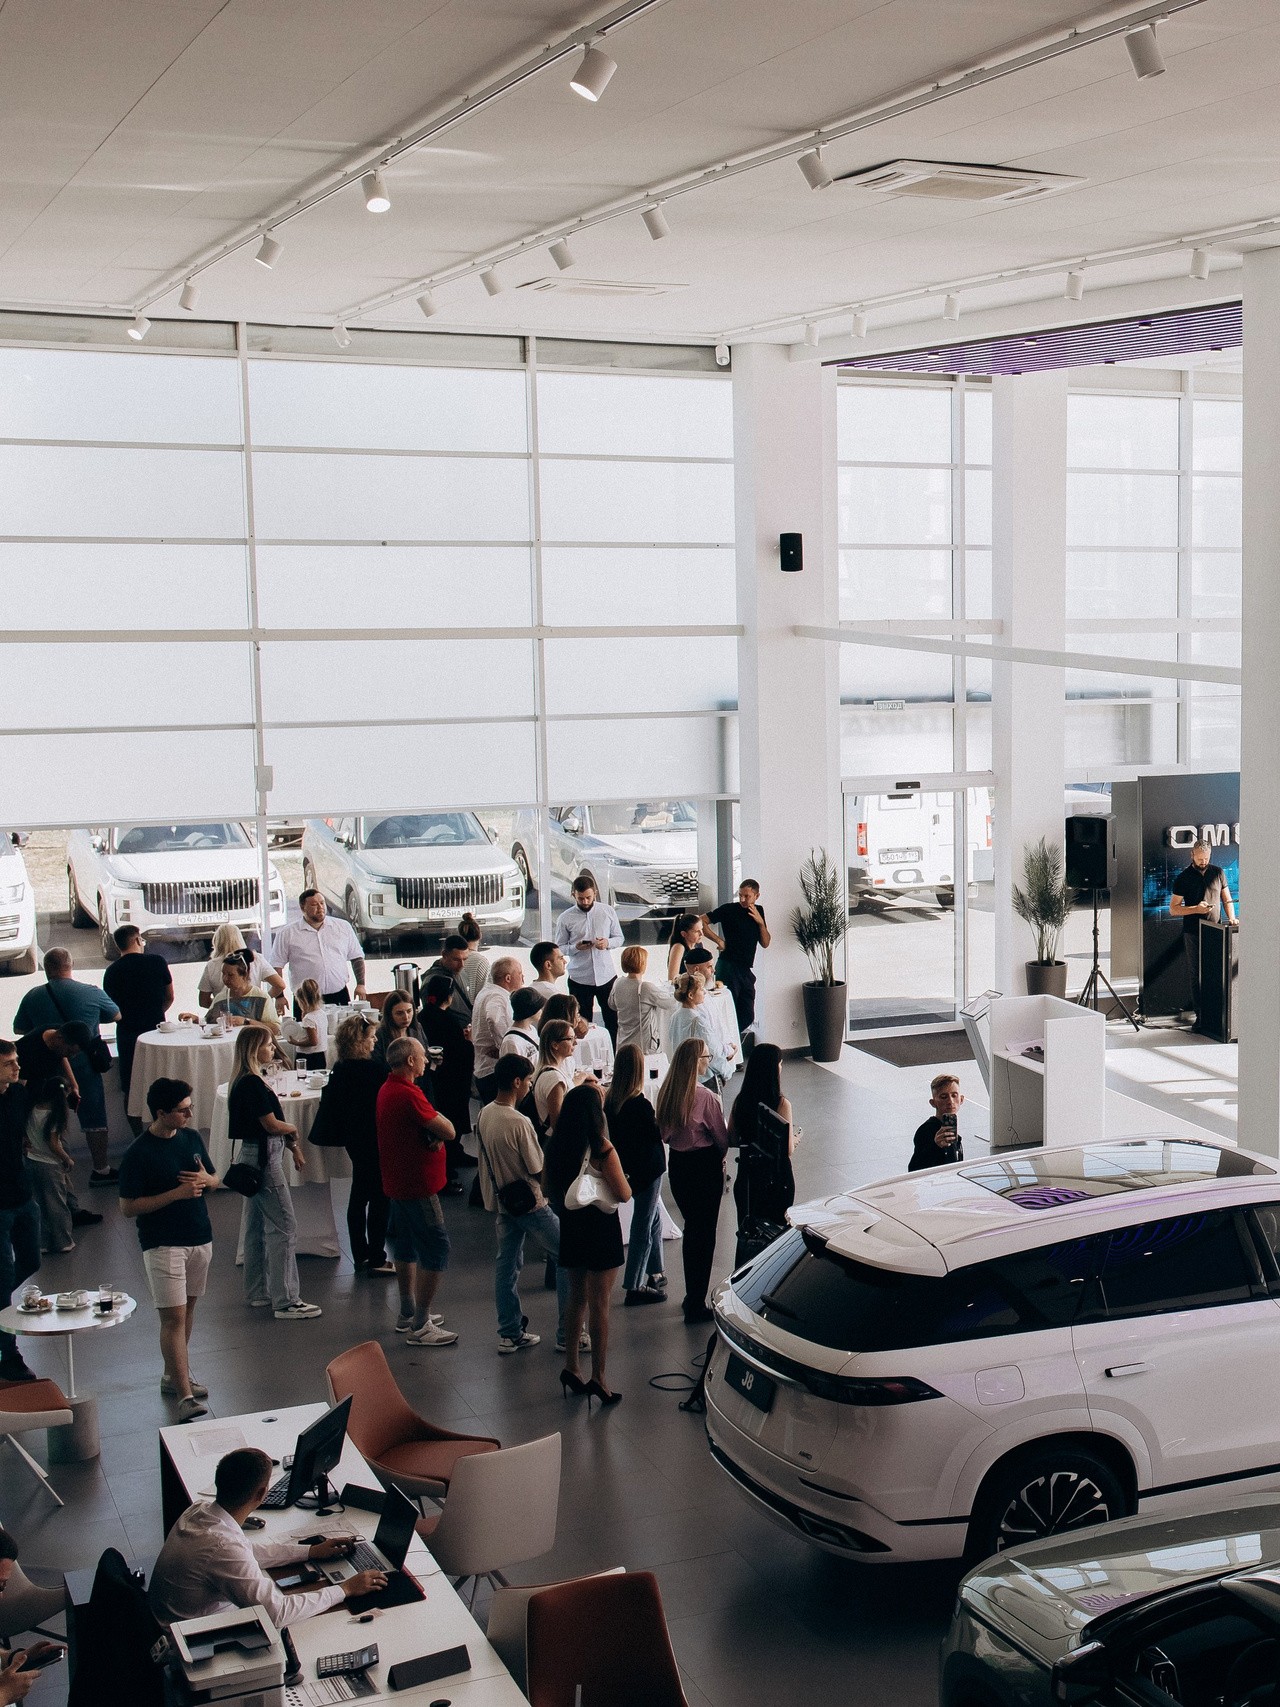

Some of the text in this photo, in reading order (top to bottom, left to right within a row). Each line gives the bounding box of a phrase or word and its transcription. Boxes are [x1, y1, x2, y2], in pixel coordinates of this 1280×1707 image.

[877, 702, 903, 710] ВЫХОД
[1169, 822, 1240, 849] OM
[741, 1370, 755, 1391] J8
